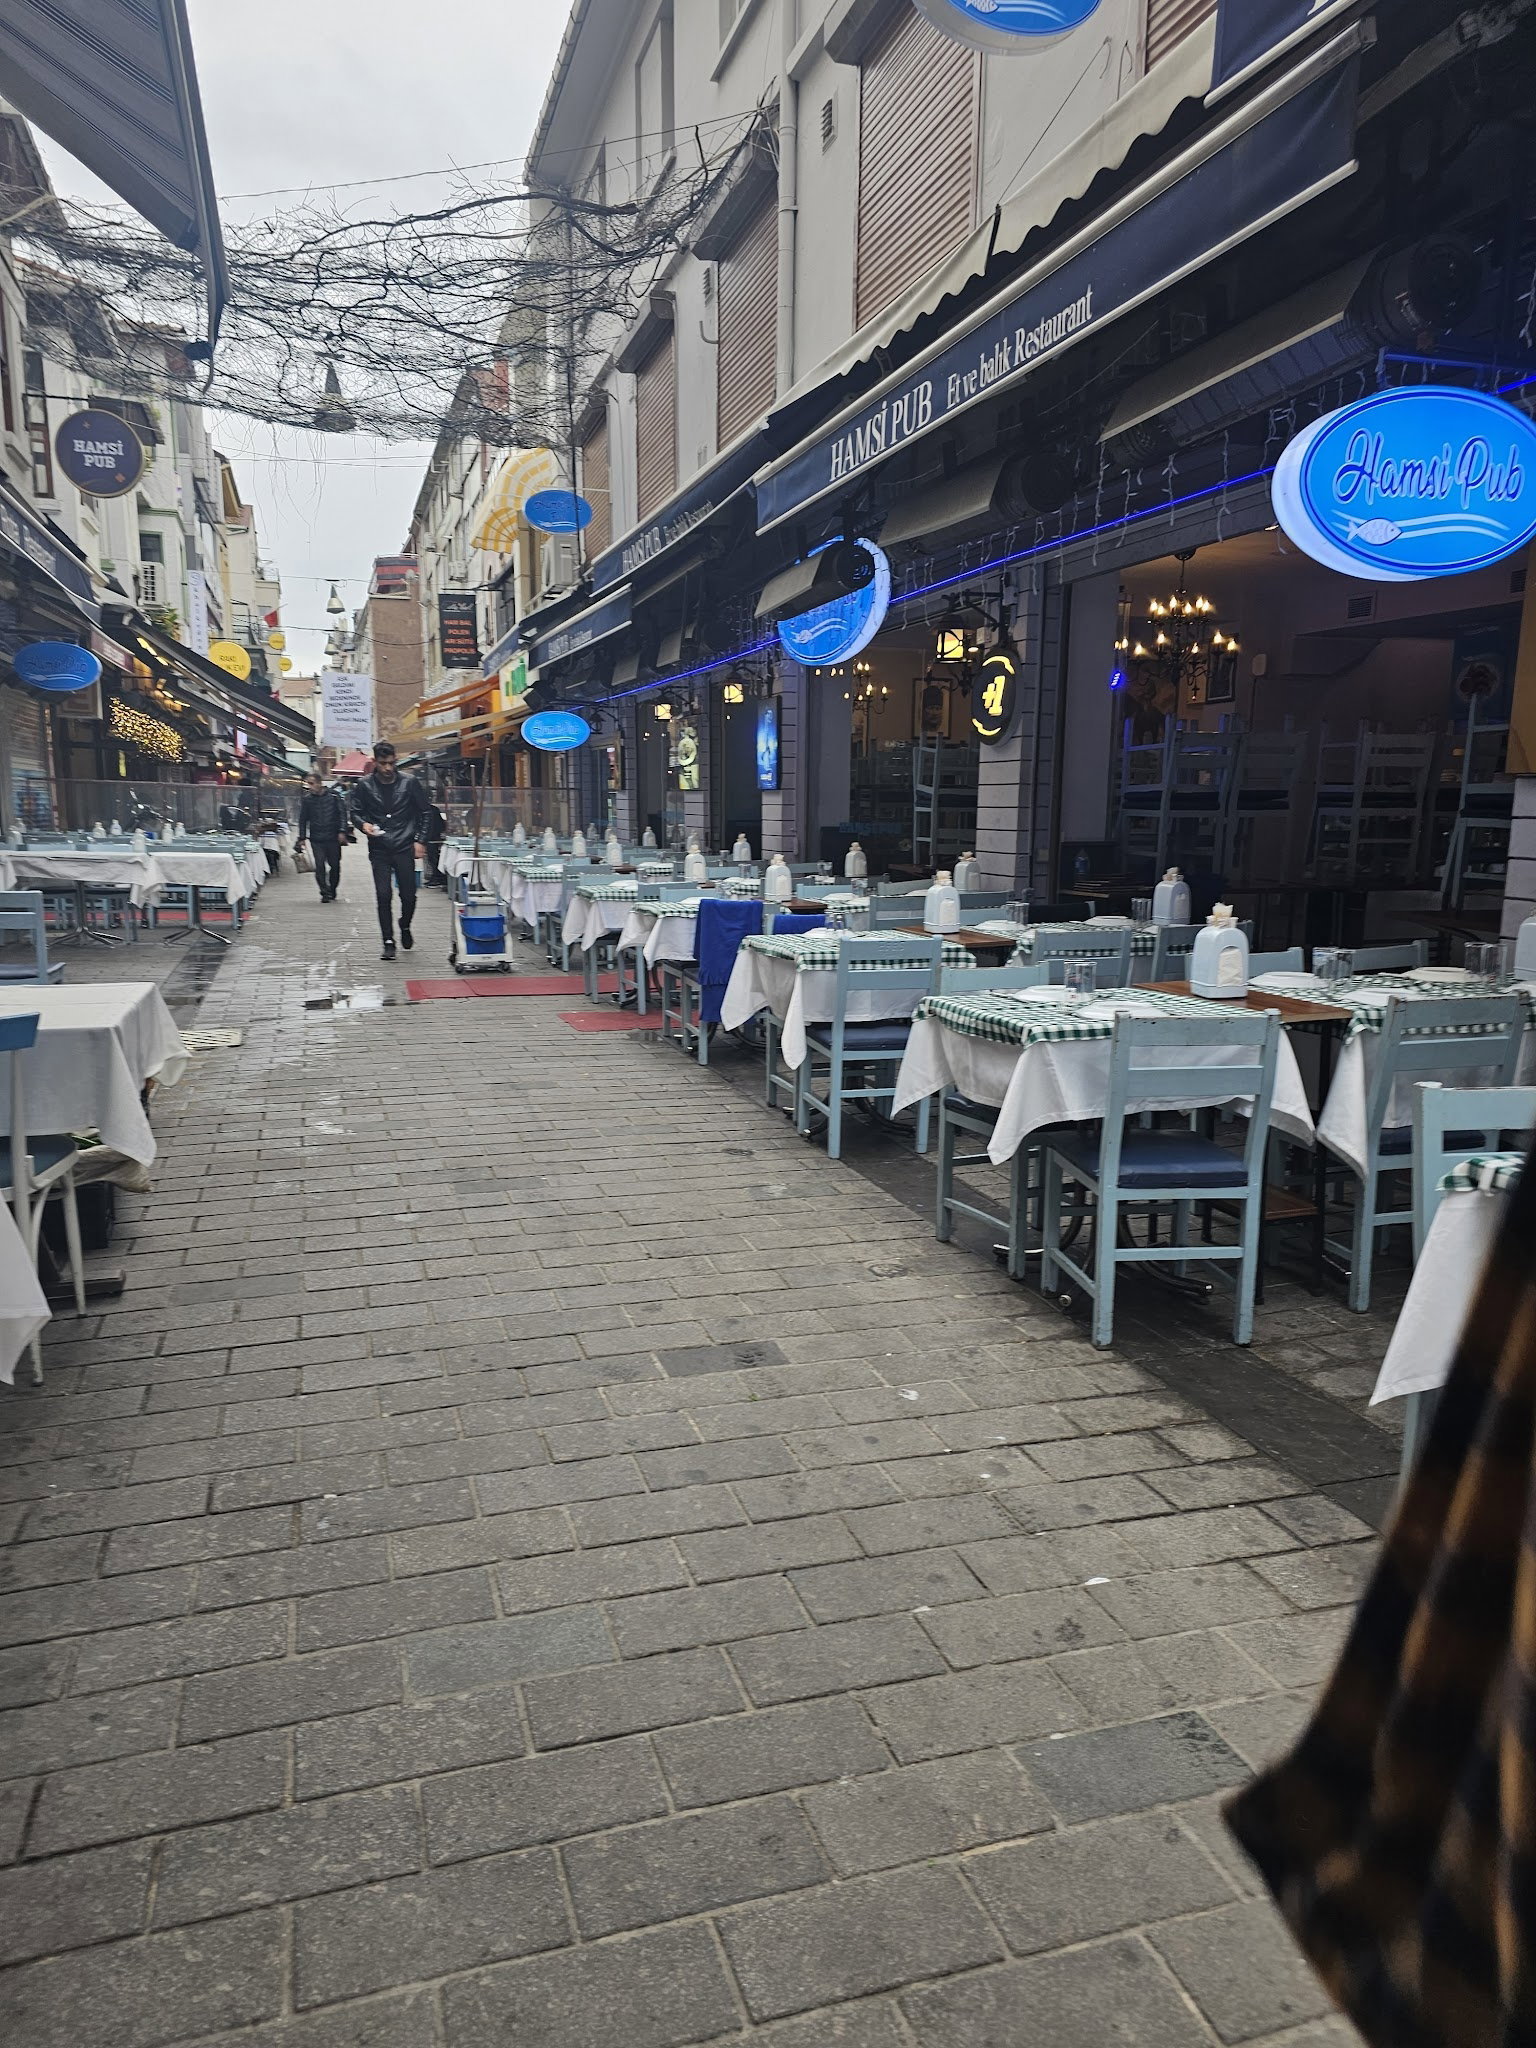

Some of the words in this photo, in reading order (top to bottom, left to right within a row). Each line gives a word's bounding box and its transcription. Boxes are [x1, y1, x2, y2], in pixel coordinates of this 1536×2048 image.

[829, 400, 887, 482] HAMSİ
[889, 380, 933, 445] PUB
[946, 373, 960, 410] Et
[962, 368, 978, 398] ve
[1013, 284, 1093, 367] Restaurant
[73, 440, 124, 456] HAMSİ
[83, 454, 116, 469] PUB
[1455, 435, 1525, 509] Pub
